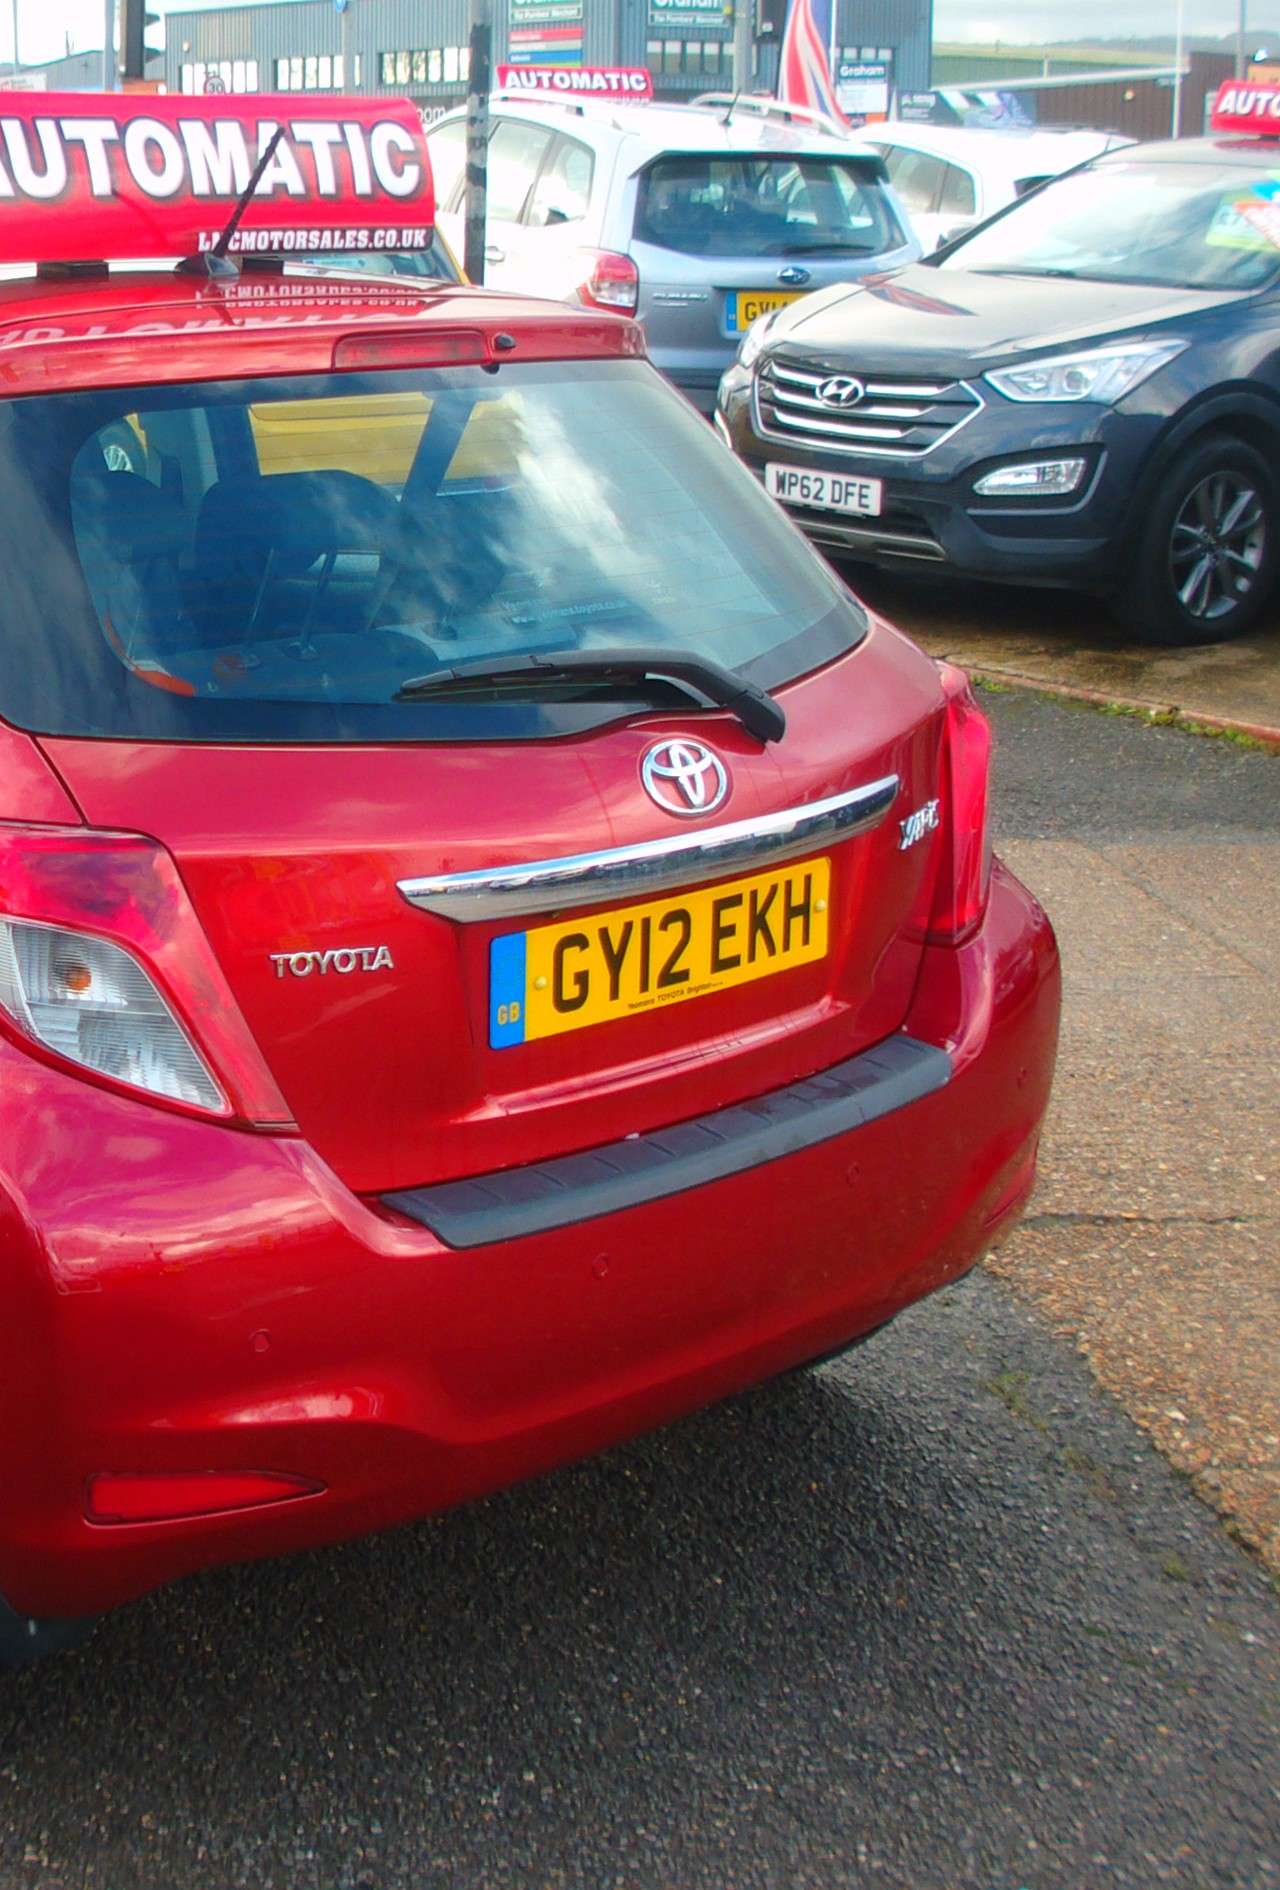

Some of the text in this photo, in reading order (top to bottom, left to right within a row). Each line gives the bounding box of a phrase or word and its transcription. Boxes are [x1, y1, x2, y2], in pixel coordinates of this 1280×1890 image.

[505, 70, 648, 92] AUTOMATIC
[839, 64, 886, 77] Graham
[207, 82, 225, 95] 30
[775, 470, 872, 509] WP62 DFE
[552, 873, 813, 1014] GY12 EKH
[270, 945, 395, 978] TOYOTA
[497, 1001, 520, 1025] GB
